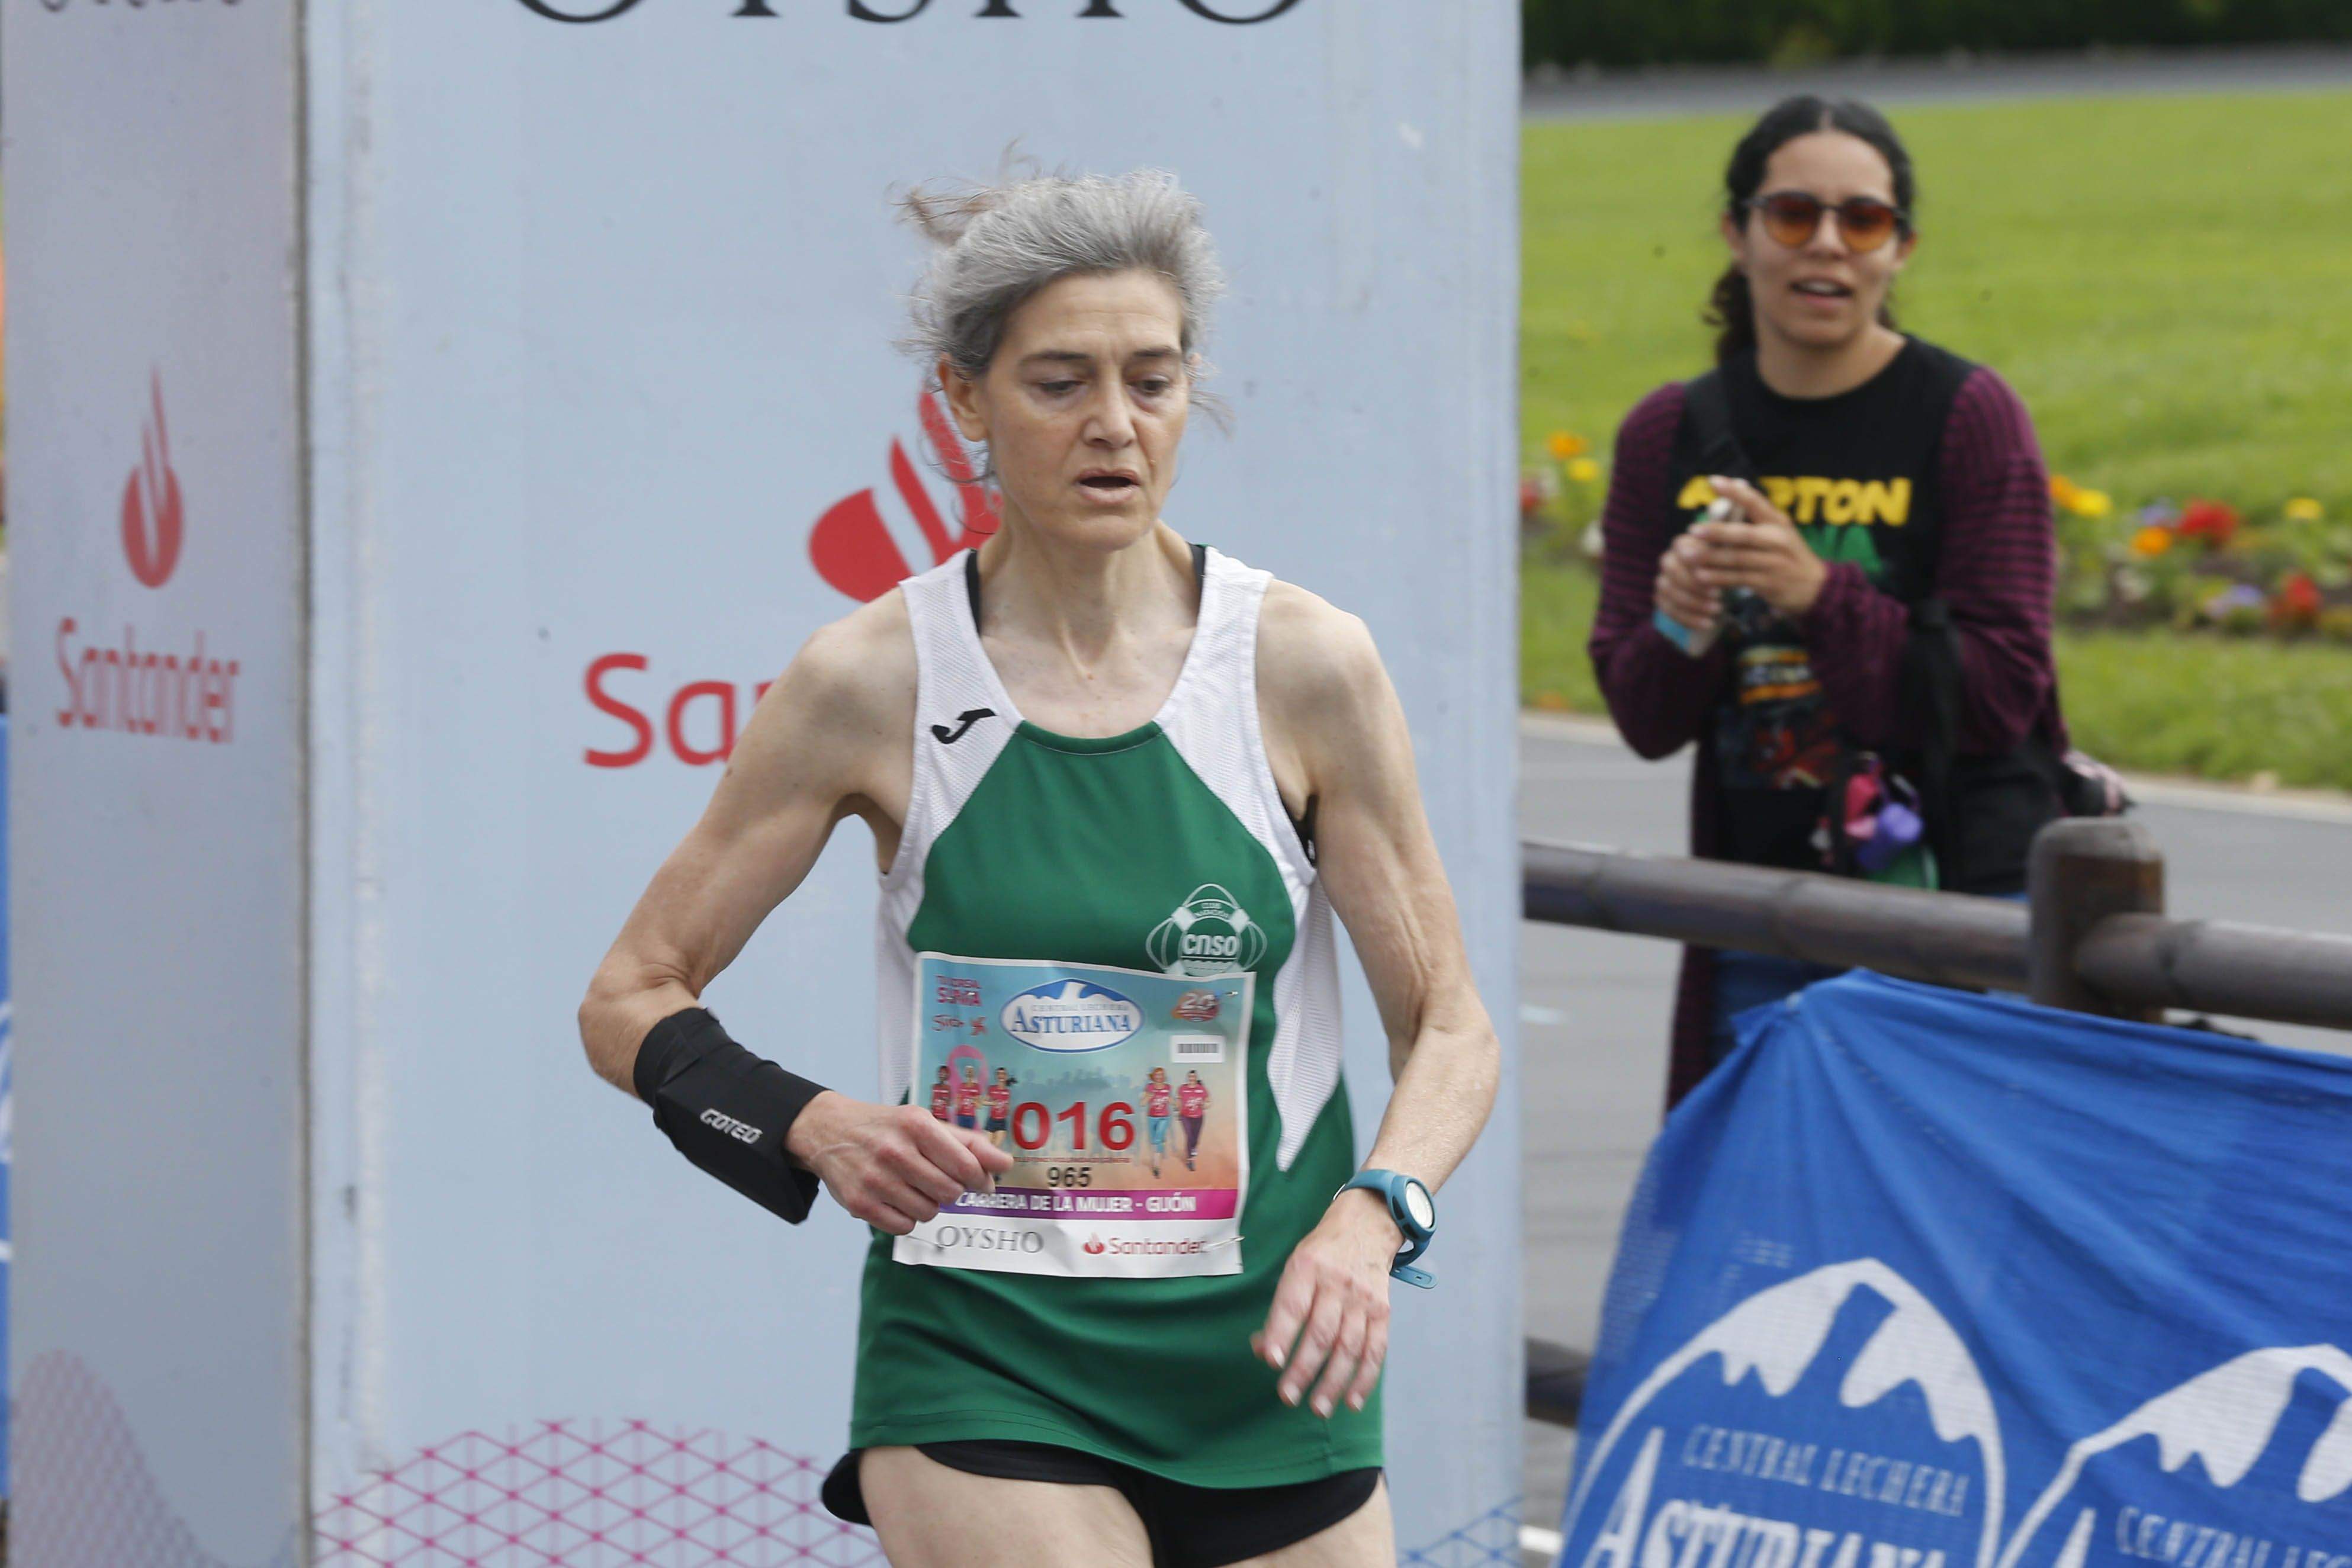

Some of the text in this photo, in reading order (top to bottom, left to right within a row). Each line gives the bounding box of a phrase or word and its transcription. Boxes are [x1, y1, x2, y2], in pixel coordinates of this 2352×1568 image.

[56, 617, 239, 744] Santander
[583, 652, 776, 768] Sa
[1011, 1005, 1133, 1033] ASTURIANA
[1013, 1101, 1135, 1151] 016
[1048, 1167, 1092, 1187] 965
[956, 1191, 1027, 1210] CARRERA
[1030, 1195, 1051, 1211] DE
[1053, 1196, 1074, 1212] LA
[1076, 1197, 1134, 1212] MUJER
[937, 1225, 1045, 1254] OYSHO
[1682, 1424, 1971, 1518] CENTRAL LECHERA
